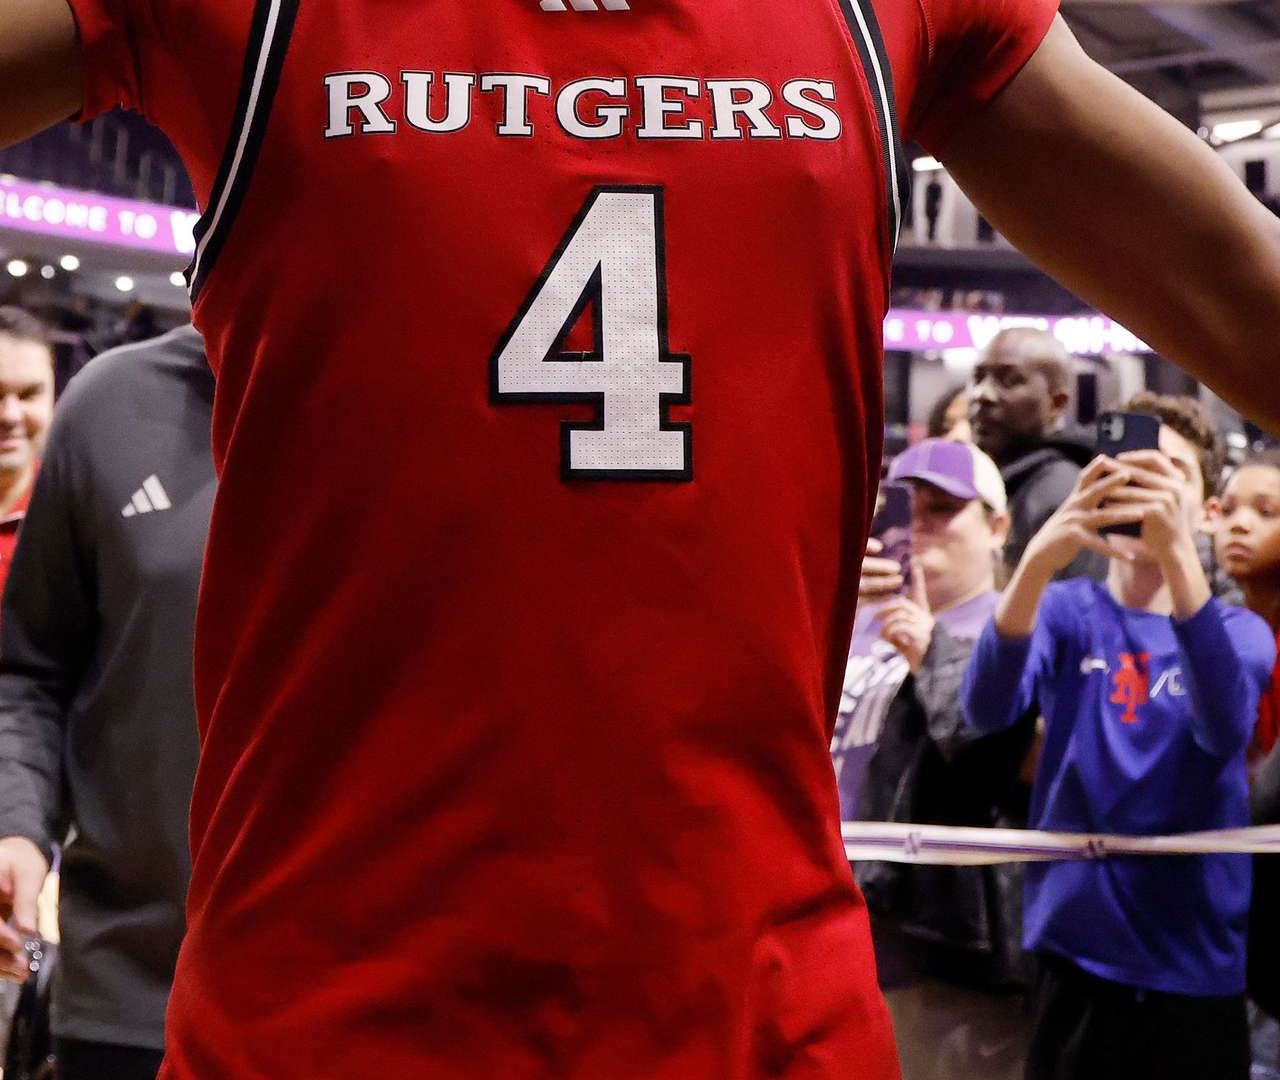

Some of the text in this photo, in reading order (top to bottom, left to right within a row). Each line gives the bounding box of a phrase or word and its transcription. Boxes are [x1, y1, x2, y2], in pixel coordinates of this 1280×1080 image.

[322, 70, 843, 142] RUTGERS
[117, 209, 158, 240] TO
[489, 184, 693, 481] 4
